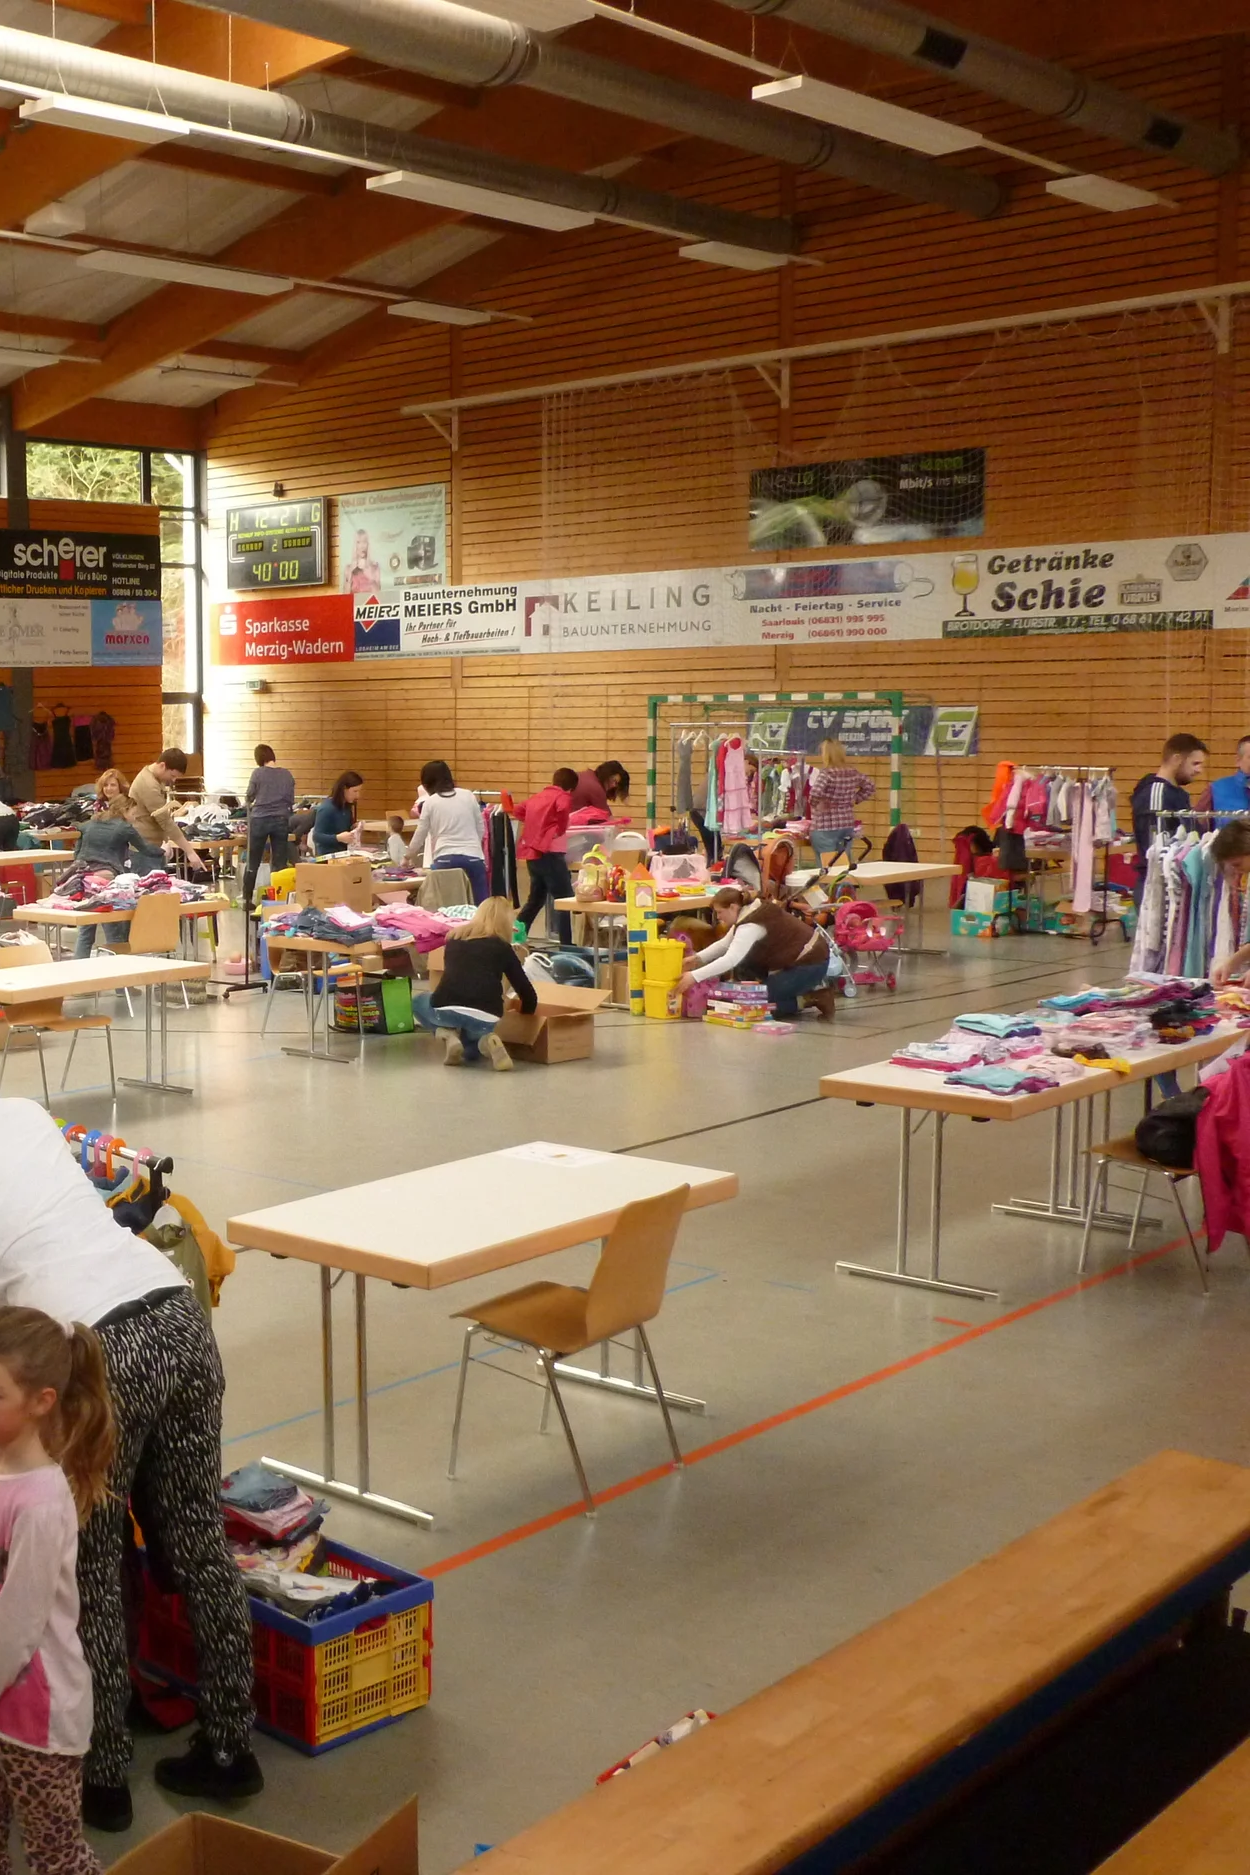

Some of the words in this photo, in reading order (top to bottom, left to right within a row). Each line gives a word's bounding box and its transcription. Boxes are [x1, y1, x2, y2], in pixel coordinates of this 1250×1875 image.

[900, 475, 933, 490] Mbit/s
[230, 512, 239, 531] H
[311, 503, 320, 522] G
[13, 537, 107, 568] scherer
[272, 539, 278, 552] 2
[987, 548, 1114, 575] Getränke
[26, 570, 58, 580] Produkte
[92, 571, 107, 581] Büro
[112, 577, 140, 585] HOTLINE
[26, 584, 57, 595] Drucken
[58, 585, 72, 595] und
[74, 585, 107, 597] Kopieren
[404, 586, 517, 602] Bauunternehmung
[563, 584, 711, 613] KEILING
[991, 577, 1106, 613] Schie
[355, 604, 400, 620] MEIERS
[404, 602, 462, 618] MEIERS
[468, 599, 517, 614] GmbH
[750, 603, 782, 614] Nacht
[794, 601, 843, 612] Feiertag
[857, 598, 901, 608] Service
[245, 617, 310, 637] Sparkasse
[406, 622, 417, 632] Ihr
[418, 620, 444, 630] Partner
[445, 618, 456, 628] für
[563, 620, 712, 637] BAUUNTERNEHMUNG
[762, 617, 805, 627] Saarlouis
[947, 619, 1003, 631] BROTDORF
[1013, 617, 1058, 629] FLURSTR.
[1066, 616, 1078, 626] 17
[105, 633, 150, 644] marxen
[422, 633, 442, 644] Hoch-
[444, 633, 450, 641] &
[452, 628, 509, 641] Tiefbauarbeiten
[762, 631, 794, 640] Merzig
[867, 627, 887, 636] 000
[245, 639, 344, 660] Merzig-Wadern
[807, 711, 838, 728] CV
